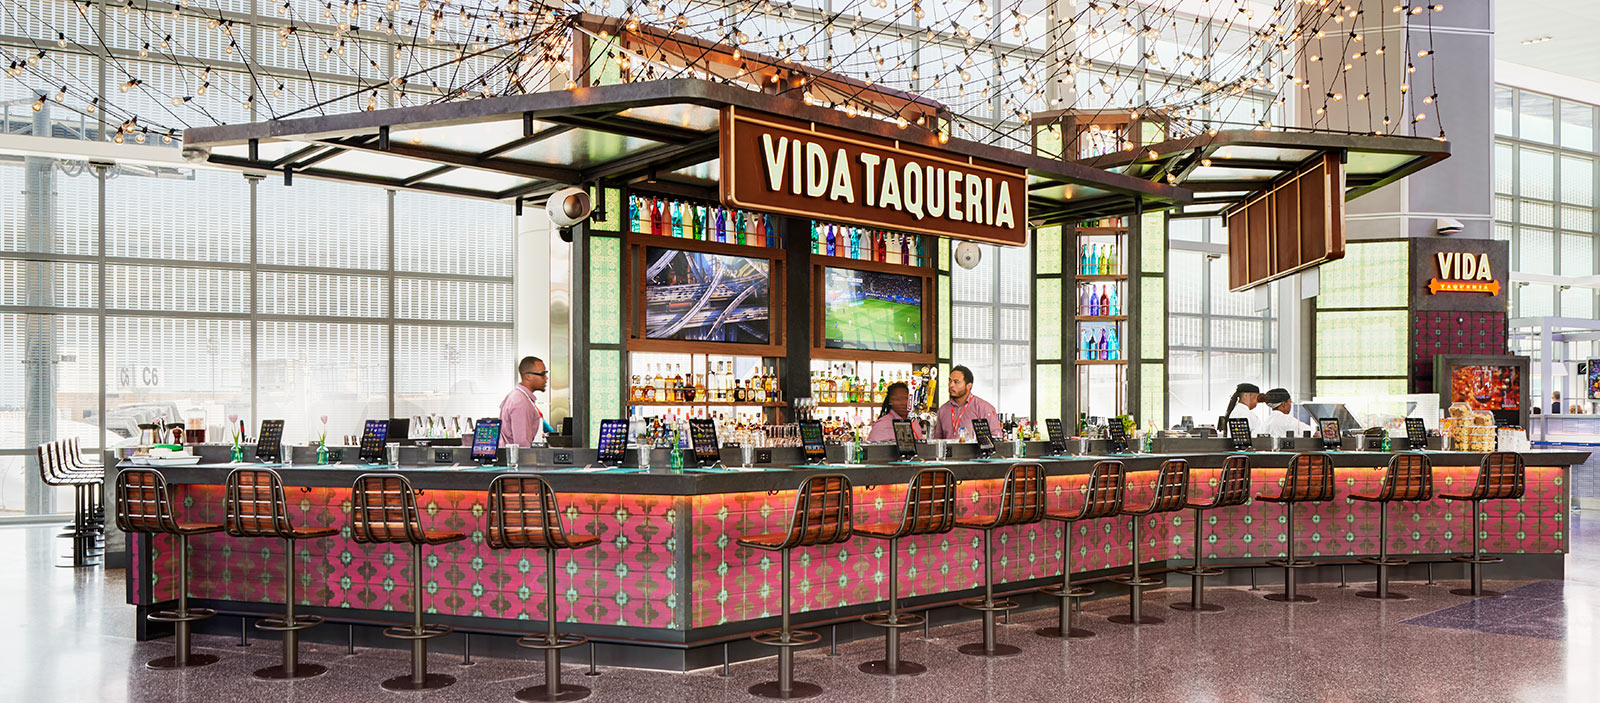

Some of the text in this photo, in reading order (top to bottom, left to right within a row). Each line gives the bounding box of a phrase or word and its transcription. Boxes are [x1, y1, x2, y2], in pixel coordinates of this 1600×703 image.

[762, 133, 1015, 230] VIDA TAQUERIA
[1437, 252, 1492, 281] VIDA
[142, 366, 159, 386] C6
